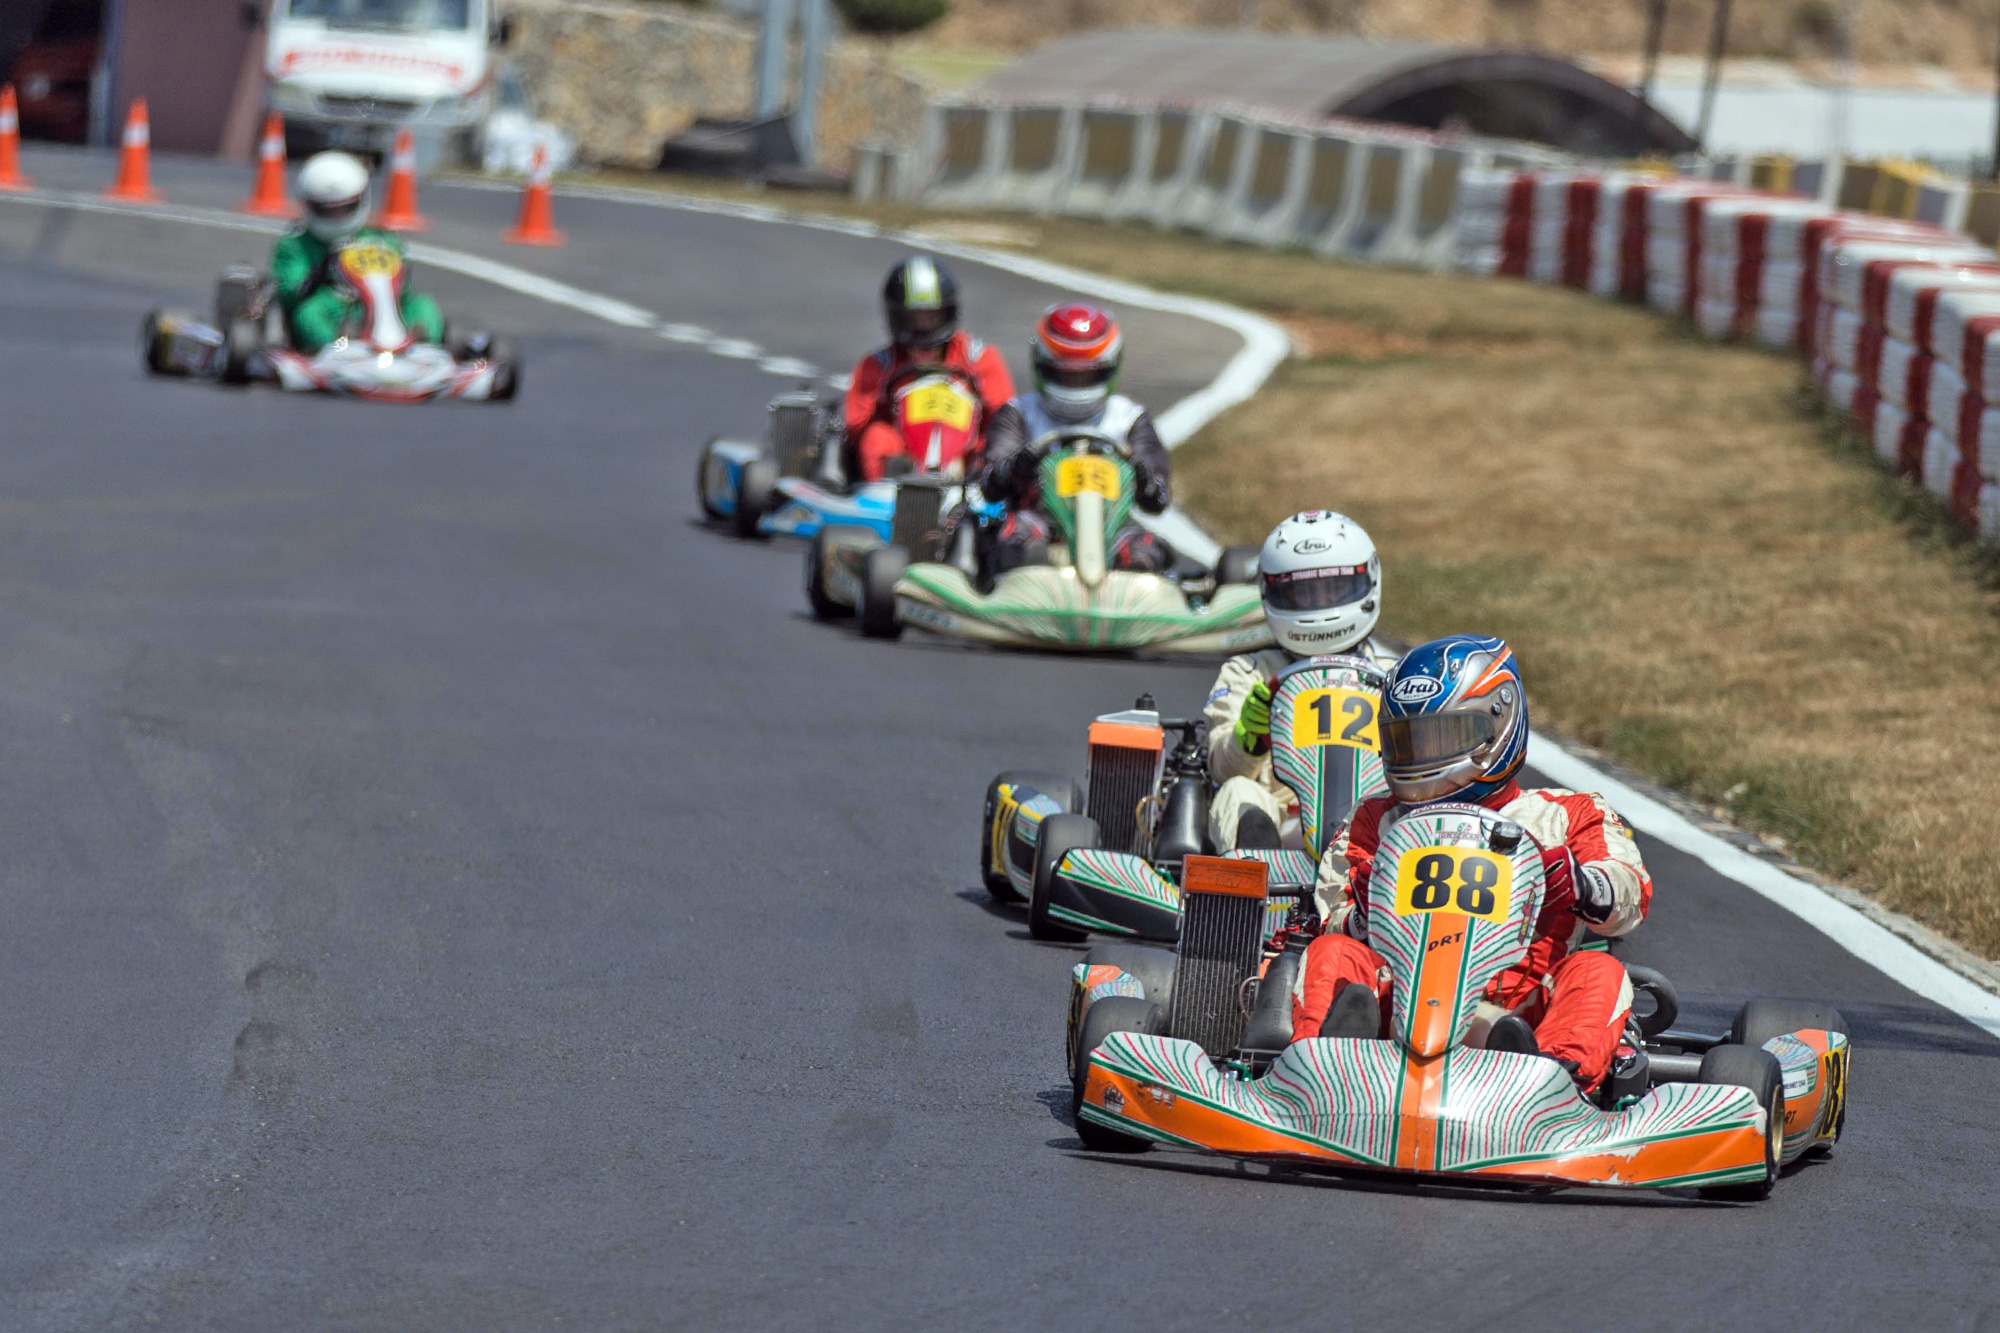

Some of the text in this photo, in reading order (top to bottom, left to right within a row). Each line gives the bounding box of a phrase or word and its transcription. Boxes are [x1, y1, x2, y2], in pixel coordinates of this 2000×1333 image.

[1394, 680, 1434, 697] Arai
[1310, 694, 1374, 747] 12
[1411, 854, 1499, 914] 88
[1428, 931, 1463, 952] DRT
